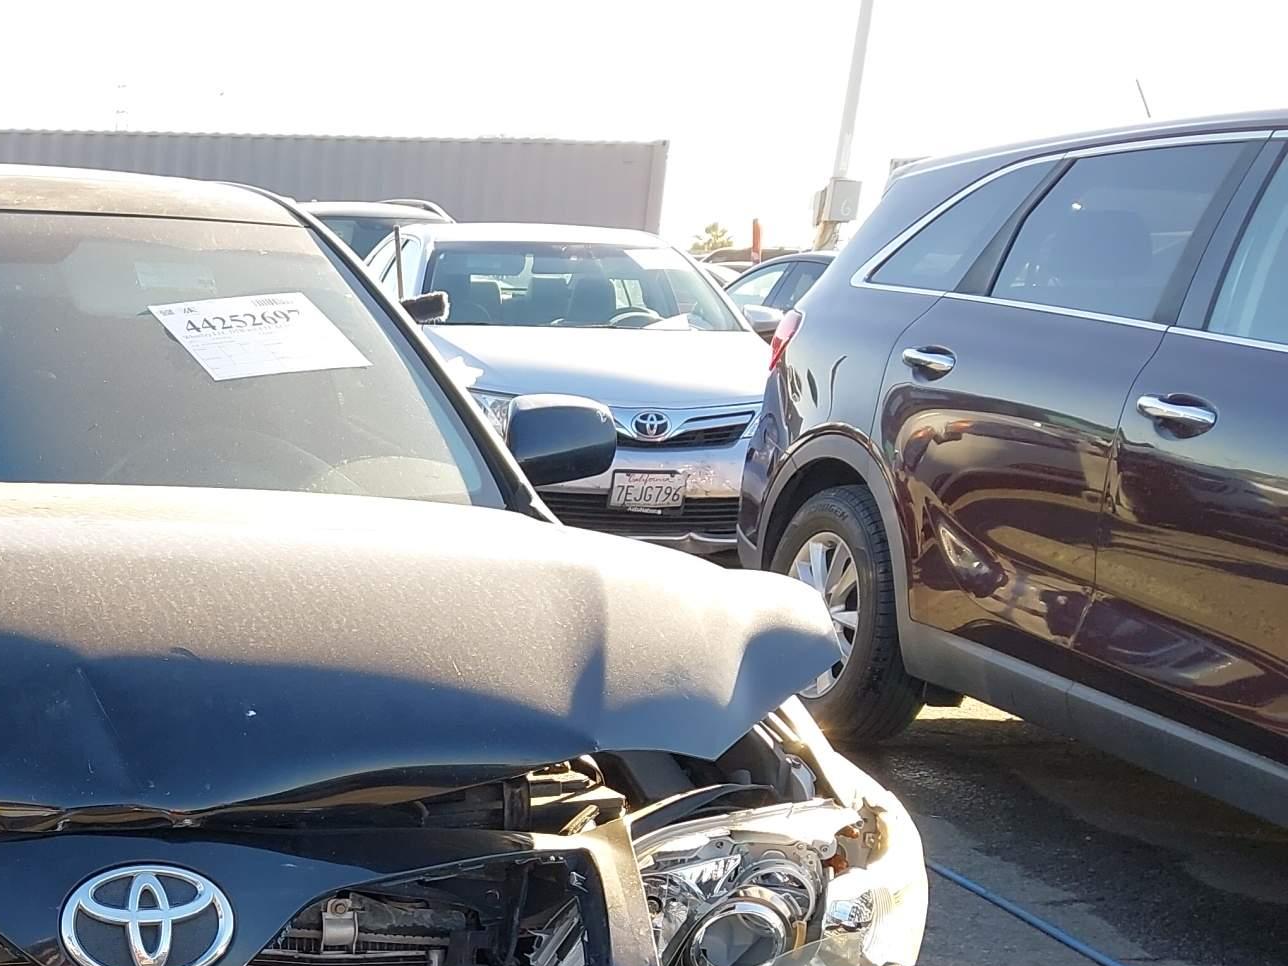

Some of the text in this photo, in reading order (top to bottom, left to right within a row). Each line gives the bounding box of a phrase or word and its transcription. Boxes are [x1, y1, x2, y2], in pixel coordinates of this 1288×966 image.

[840, 200, 851, 216] 6
[628, 474, 674, 485] California
[616, 485, 683, 503] 7EJG796
